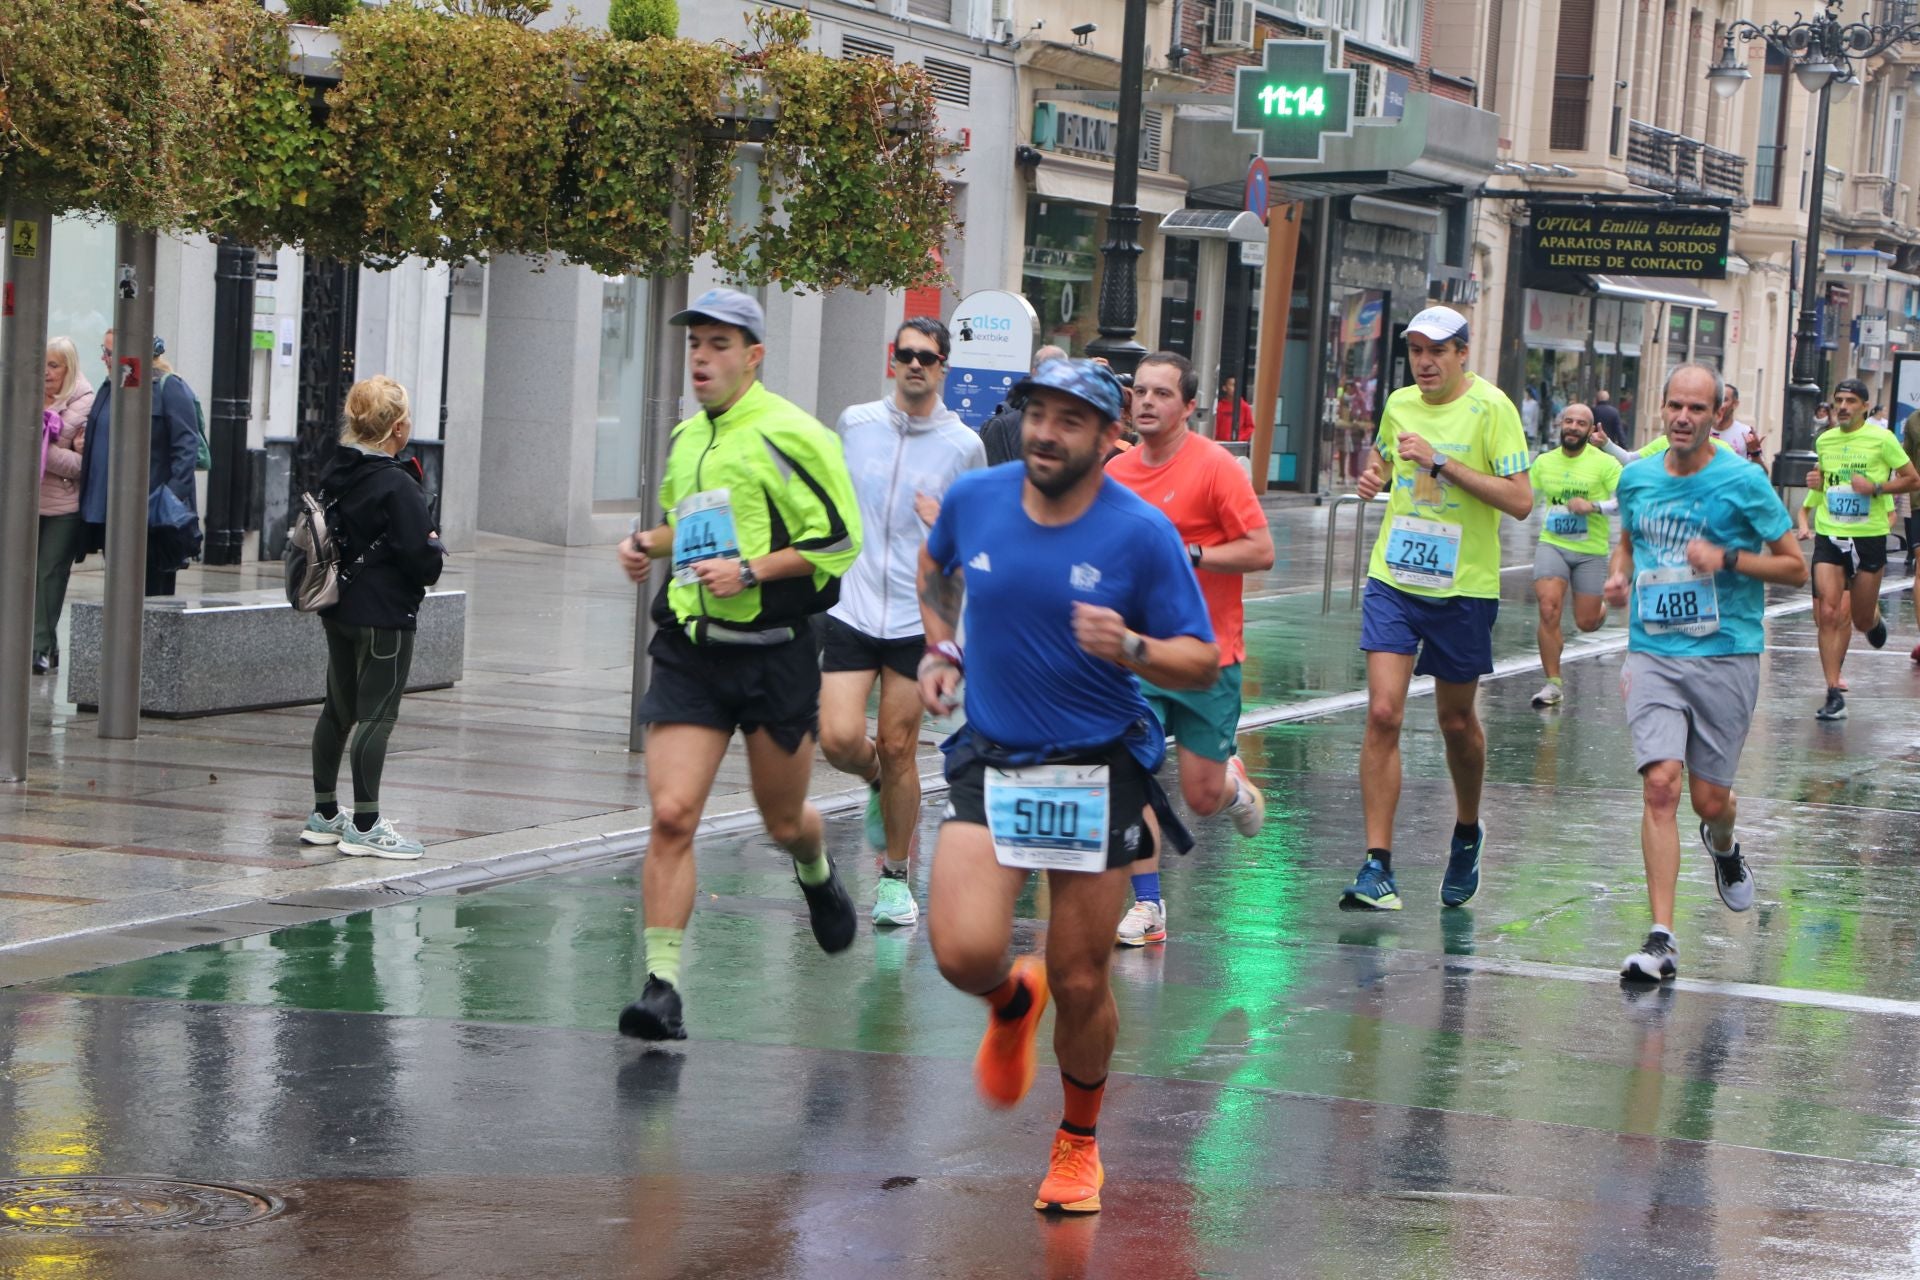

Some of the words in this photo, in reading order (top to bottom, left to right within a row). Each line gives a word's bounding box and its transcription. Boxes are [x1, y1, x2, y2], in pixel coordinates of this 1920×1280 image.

[1258, 85, 1326, 116] 11:14
[1060, 111, 1151, 161] FARMA
[1537, 216, 1592, 232] OPTICA
[1600, 219, 1649, 235] Emilia
[1656, 221, 1722, 237] Barriada
[1539, 236, 1612, 250] APARATOS
[1616, 239, 1653, 253] PARA
[1659, 241, 1717, 254] SORDOS
[1550, 254, 1601, 267] LENTES
[1606, 256, 1625, 268] DE
[1631, 257, 1703, 271] CONTACTO
[972, 315, 1012, 330] alsa
[1836, 498, 1860, 513] 375
[1555, 518, 1578, 532] 632
[1400, 540, 1439, 569] 234
[1656, 590, 1698, 618] 488
[1015, 798, 1079, 837] 500
